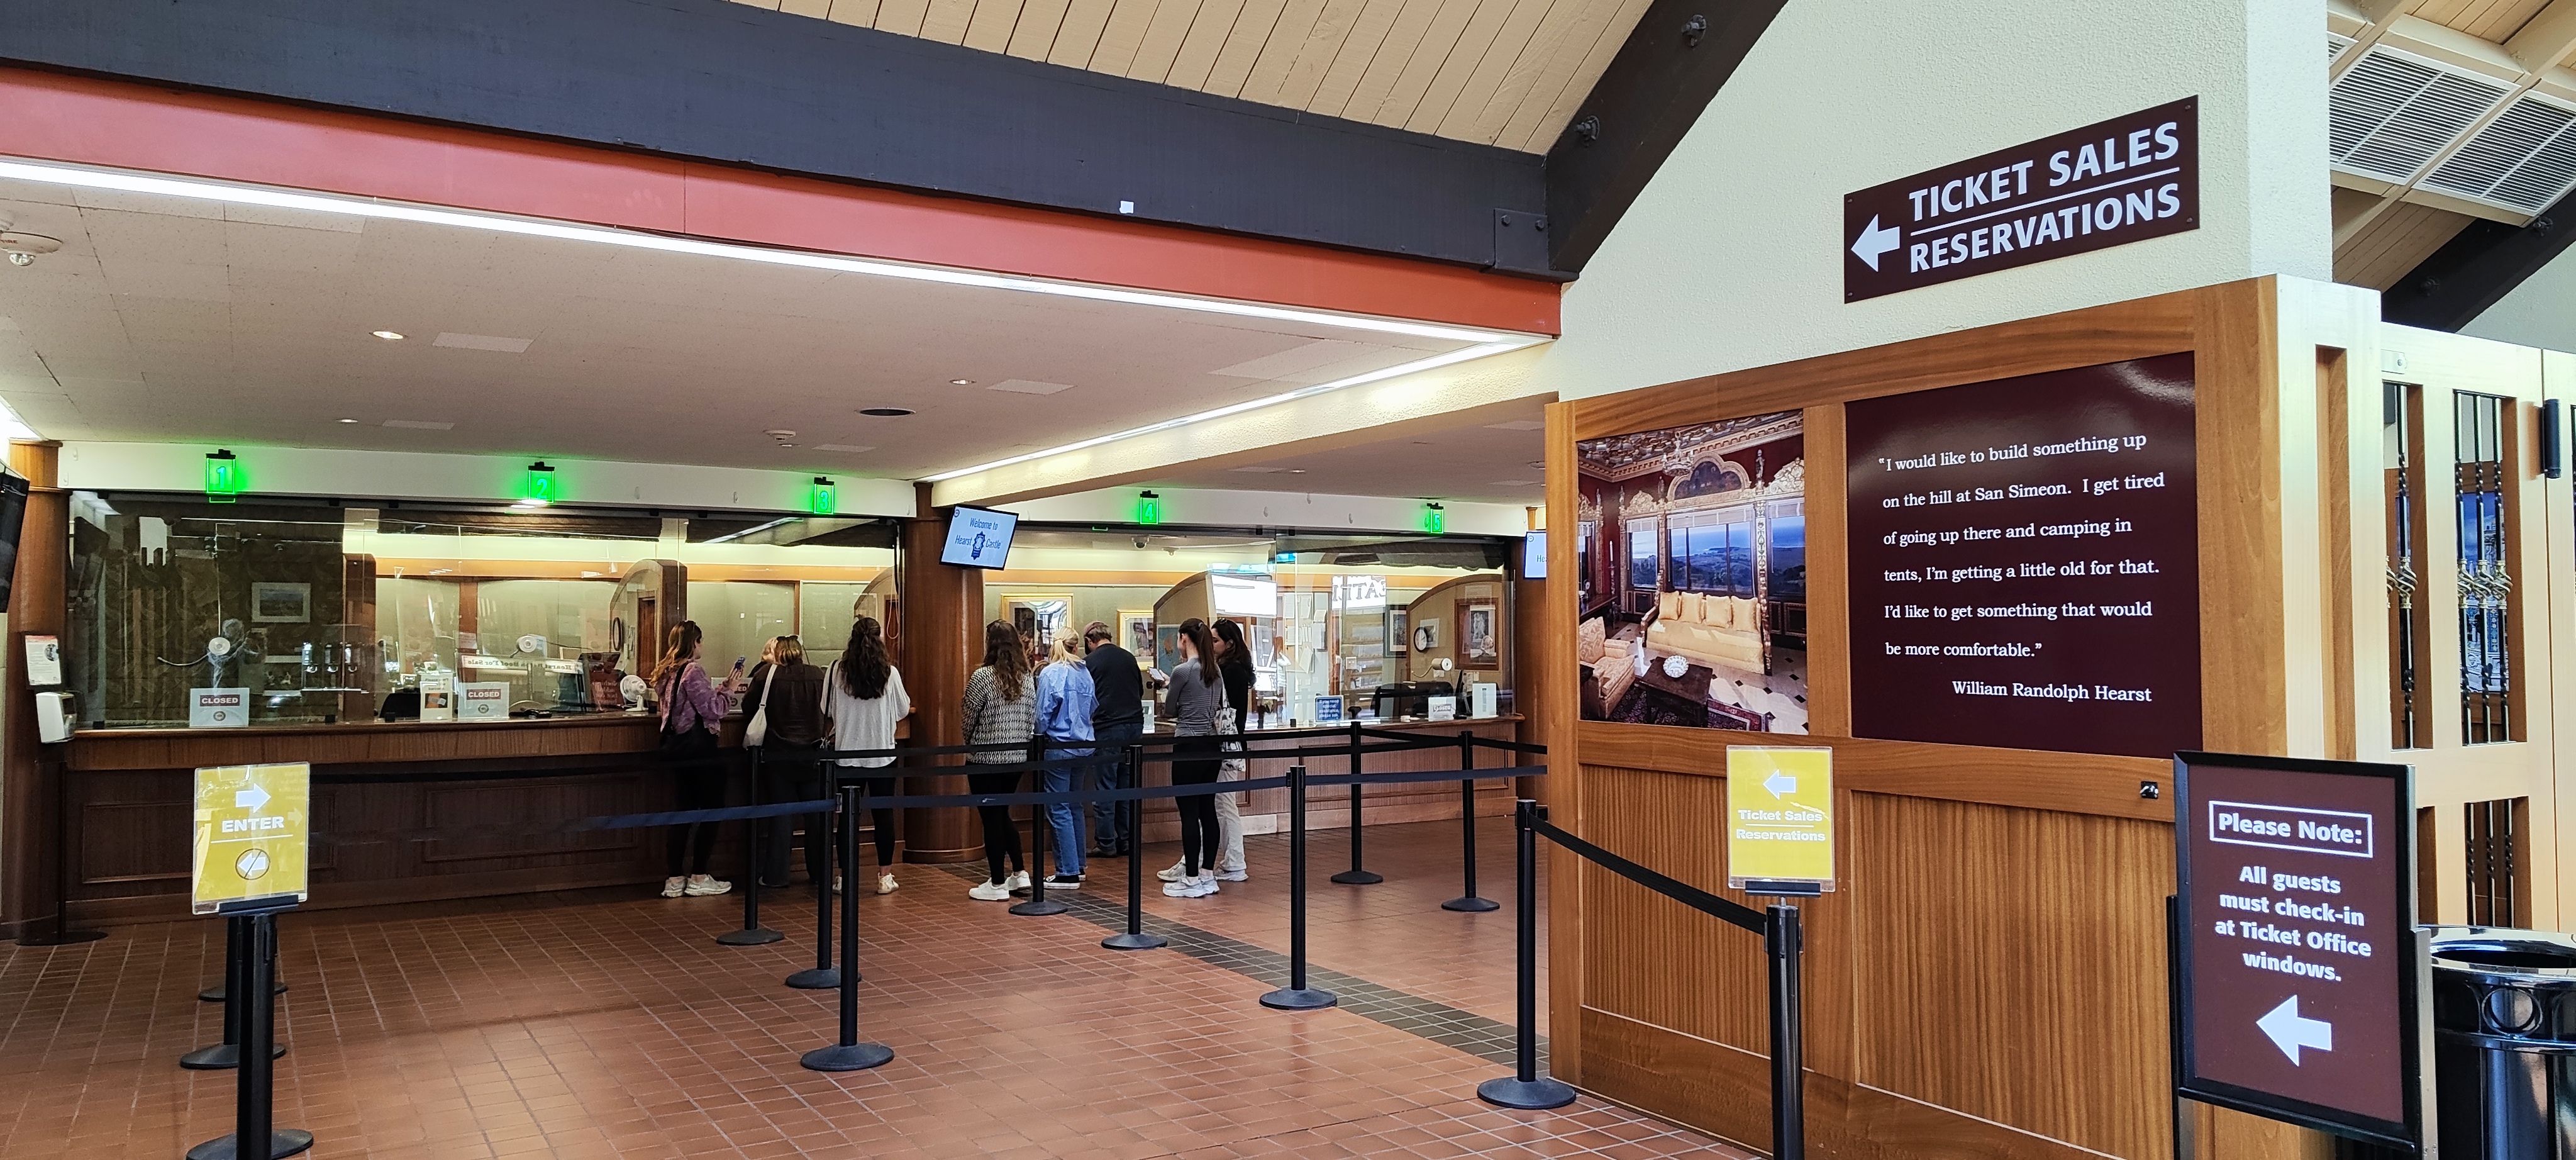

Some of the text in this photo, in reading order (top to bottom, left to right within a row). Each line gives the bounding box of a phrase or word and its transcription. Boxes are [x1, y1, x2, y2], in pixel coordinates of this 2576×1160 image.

[1909, 121, 2179, 222] TICKET SALES
[1910, 183, 2180, 274] RESERVATIONS
[1894, 453, 1937, 470] would
[1940, 451, 1966, 466] like
[1969, 450, 1985, 463] to
[1988, 443, 2029, 461] build
[2033, 436, 2119, 457] something
[2122, 435, 2146, 450] up
[216, 466, 225, 489] 1
[536, 478, 548, 499] 2
[819, 491, 828, 510] 3
[1882, 471, 2165, 508] on the hill at San Simeon. I get tired
[1145, 503, 1154, 521] 4
[1435, 515, 1440, 530] 5
[969, 517, 999, 530] Welcome to
[1883, 518, 2133, 547] of going up there and camping in
[955, 534, 1002, 549] Hearst Castle
[1536, 554, 1547, 562] He
[1884, 559, 2160, 583] tents, I’m getting a little old for that.
[1884, 601, 2153, 621] I’d like to get something that would
[1885, 642, 2042, 657] be more comfortable.”
[1951, 681, 2152, 703] William Randolph Hearst
[221, 816, 284, 833] ENTER
[1738, 809, 1823, 822] Ticket Sales
[1736, 828, 1826, 842] Reservations
[2218, 813, 2362, 844] Please Note:
[2239, 866, 2341, 894] All guests
[2219, 894, 2365, 927] must check-in
[2214, 920, 2372, 957] at Ticket Office
[2242, 951, 2342, 982] windows.
